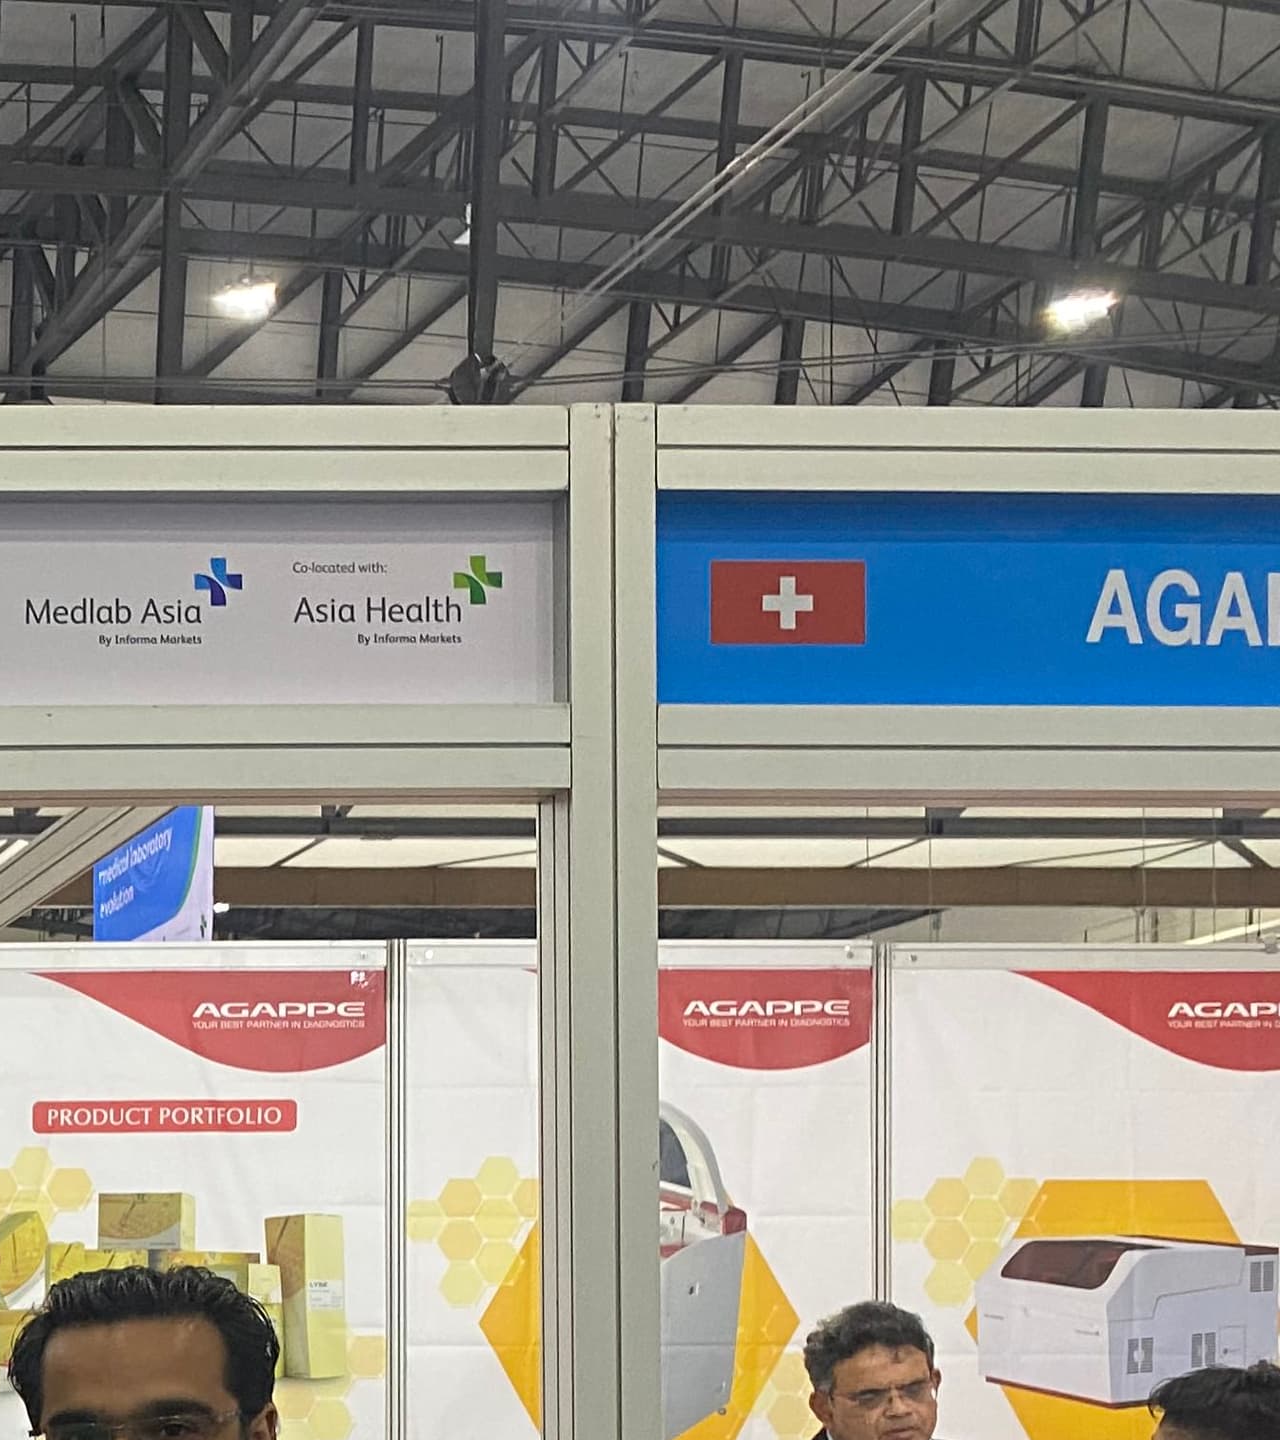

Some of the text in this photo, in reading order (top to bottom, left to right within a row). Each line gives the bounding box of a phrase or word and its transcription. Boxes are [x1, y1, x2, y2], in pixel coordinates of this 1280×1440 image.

[292, 562, 388, 574] Co-located with:
[25, 597, 202, 625] Medlab Asia
[294, 596, 462, 624] Asia Health
[99, 634, 202, 647] By Informa Markets
[357, 633, 462, 646] By Informa Markets
[193, 1002, 366, 1018] AGAPPE
[683, 1000, 850, 1016] AGAPPE
[1167, 1002, 1280, 1018] AGAP
[192, 1020, 365, 1029] YOUR BEST PARTNER IN DIAGNOSTICS
[683, 1018, 708, 1027] YOUR
[709, 1018, 733, 1027] BEST
[778, 1018, 788, 1027] IN
[46, 1106, 282, 1127] PRODUCT PORTFOLIO
